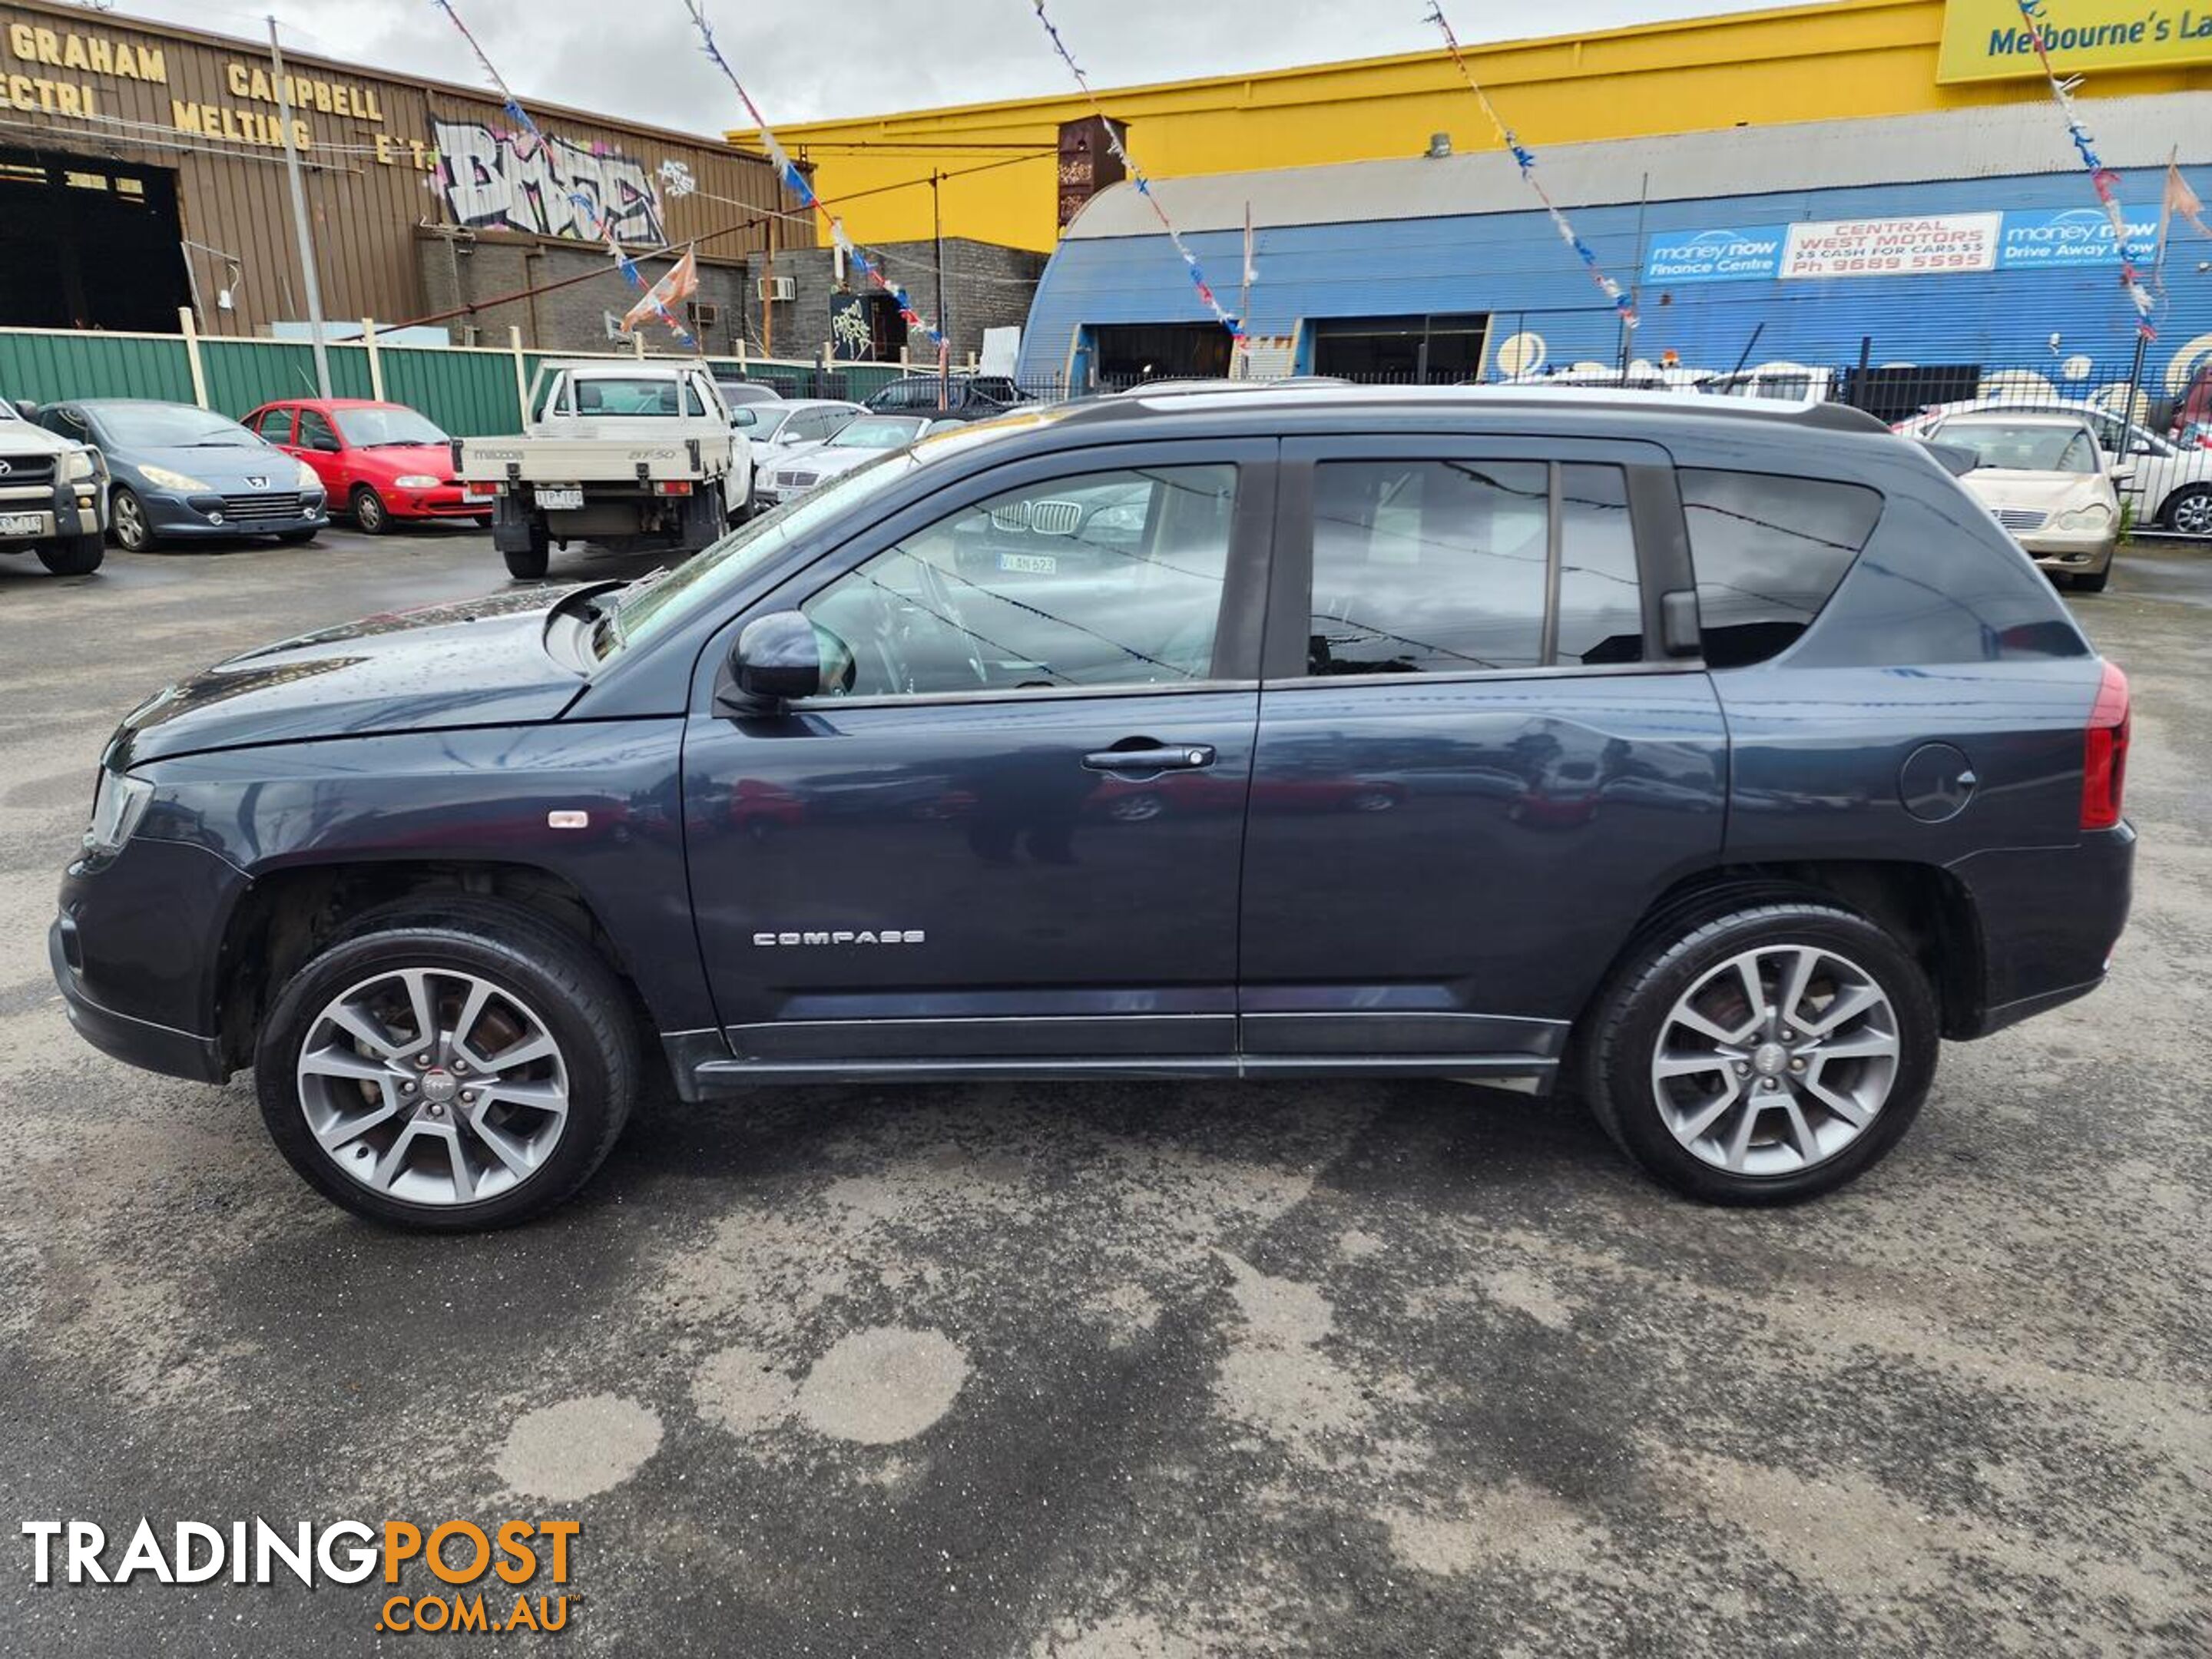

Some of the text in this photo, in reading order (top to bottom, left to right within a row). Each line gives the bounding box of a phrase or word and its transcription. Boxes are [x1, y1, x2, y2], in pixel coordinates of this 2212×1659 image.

[10, 24, 382, 121] GRAHAM CAMPBELL
[173, 101, 310, 151] MELTING
[1836, 220, 1948, 236] CENTRAL
[2007, 225, 2097, 242] money
[1800, 230, 1983, 250] WEST MOTORS
[1653, 242, 1778, 261] money now
[1821, 248, 1865, 258] CASH
[1872, 247, 1905, 256] FOR
[1911, 244, 1955, 253] CARS
[2005, 246, 2051, 258] Drive
[2056, 243, 2108, 257] Away
[1650, 259, 1773, 276] Finance Centre
[1833, 257, 1900, 271] 9689
[753, 930, 925, 946] COMPASS
